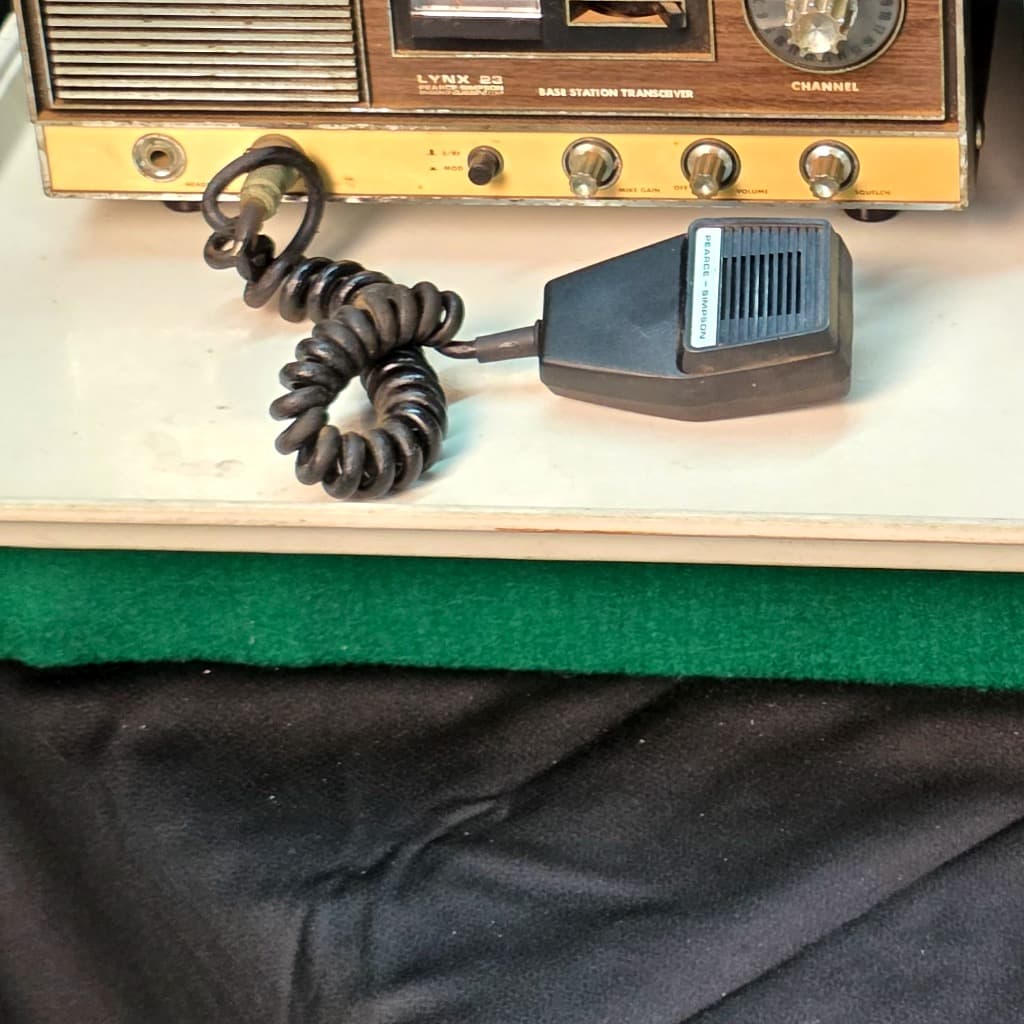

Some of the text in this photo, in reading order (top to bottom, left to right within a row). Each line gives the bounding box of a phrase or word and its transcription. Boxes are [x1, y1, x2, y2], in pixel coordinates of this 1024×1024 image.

[416, 74, 504, 85] LYNX 23
[791, 80, 860, 93] CHANNEL
[538, 87, 694, 99] BASE STATION TRANSCEIVER
